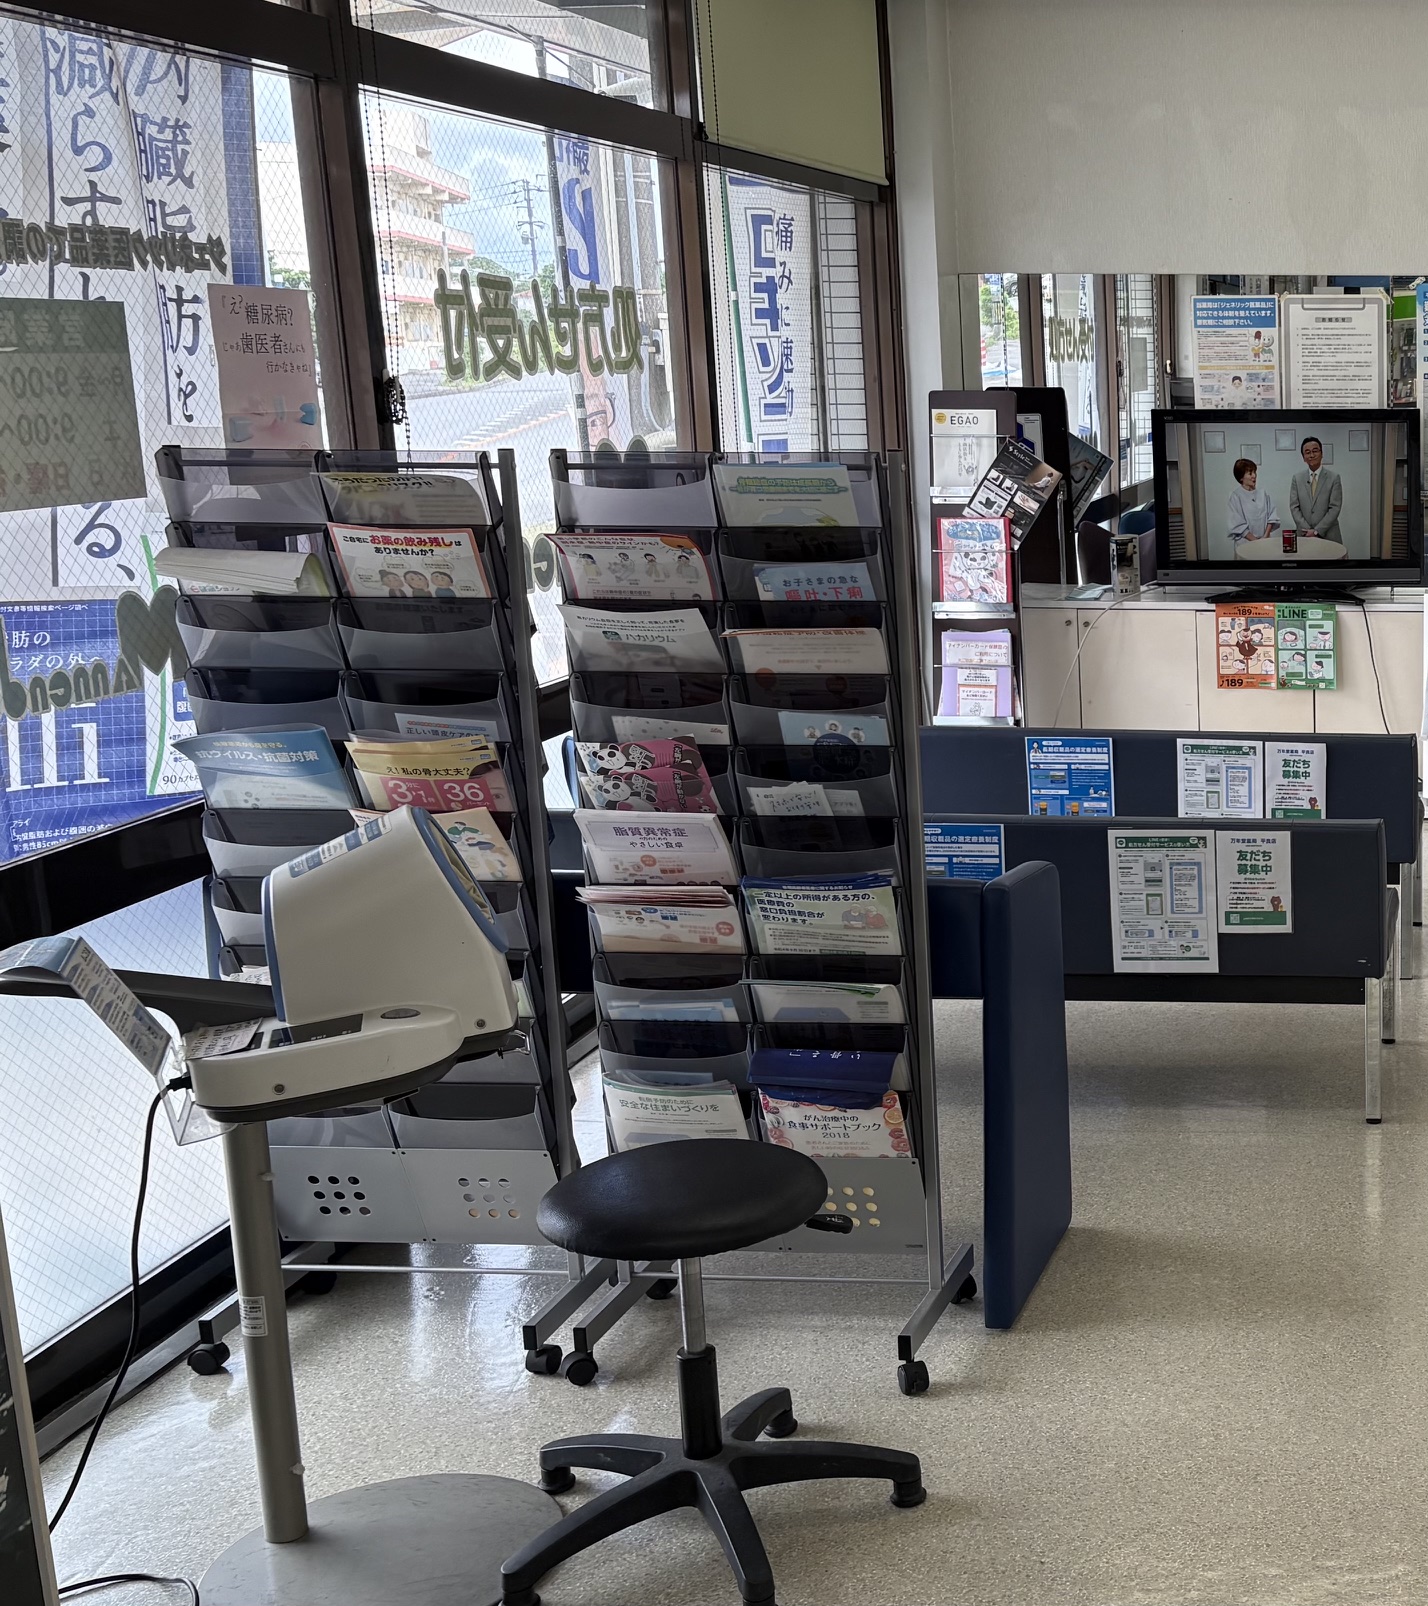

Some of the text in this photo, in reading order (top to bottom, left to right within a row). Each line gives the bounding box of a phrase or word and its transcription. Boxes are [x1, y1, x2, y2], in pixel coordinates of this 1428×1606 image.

[950, 415, 979, 425] EGAO
[342, 535, 462, 547] ご自宅にお薬の飲み残しは
[374, 546, 435, 557] ありませんか?
[782, 575, 860, 587] お子さまの急な
[1282, 610, 1307, 618] LINE
[6, 631, 50, 648] 肪の
[1226, 679, 1243, 687] 189
[1282, 758, 1311, 769] 友だち
[1282, 769, 1311, 780] 募集中
[443, 783, 485, 801] 36
[613, 826, 688, 837] 脂質異常症
[629, 841, 684, 849] やさしい食卓
[1237, 850, 1272, 861] 友だち
[1237, 863, 1272, 876] 募集中
[754, 891, 876, 902] 一定以上の所得がある方の、
[759, 907, 825, 919] 窓口負担割合が
[762, 914, 814, 926] 変わります。
[619, 1099, 720, 1113] 安全な住まいづくりを
[804, 1114, 859, 1122] がん治療中の
[787, 1121, 882, 1132] 食事サポートブック
